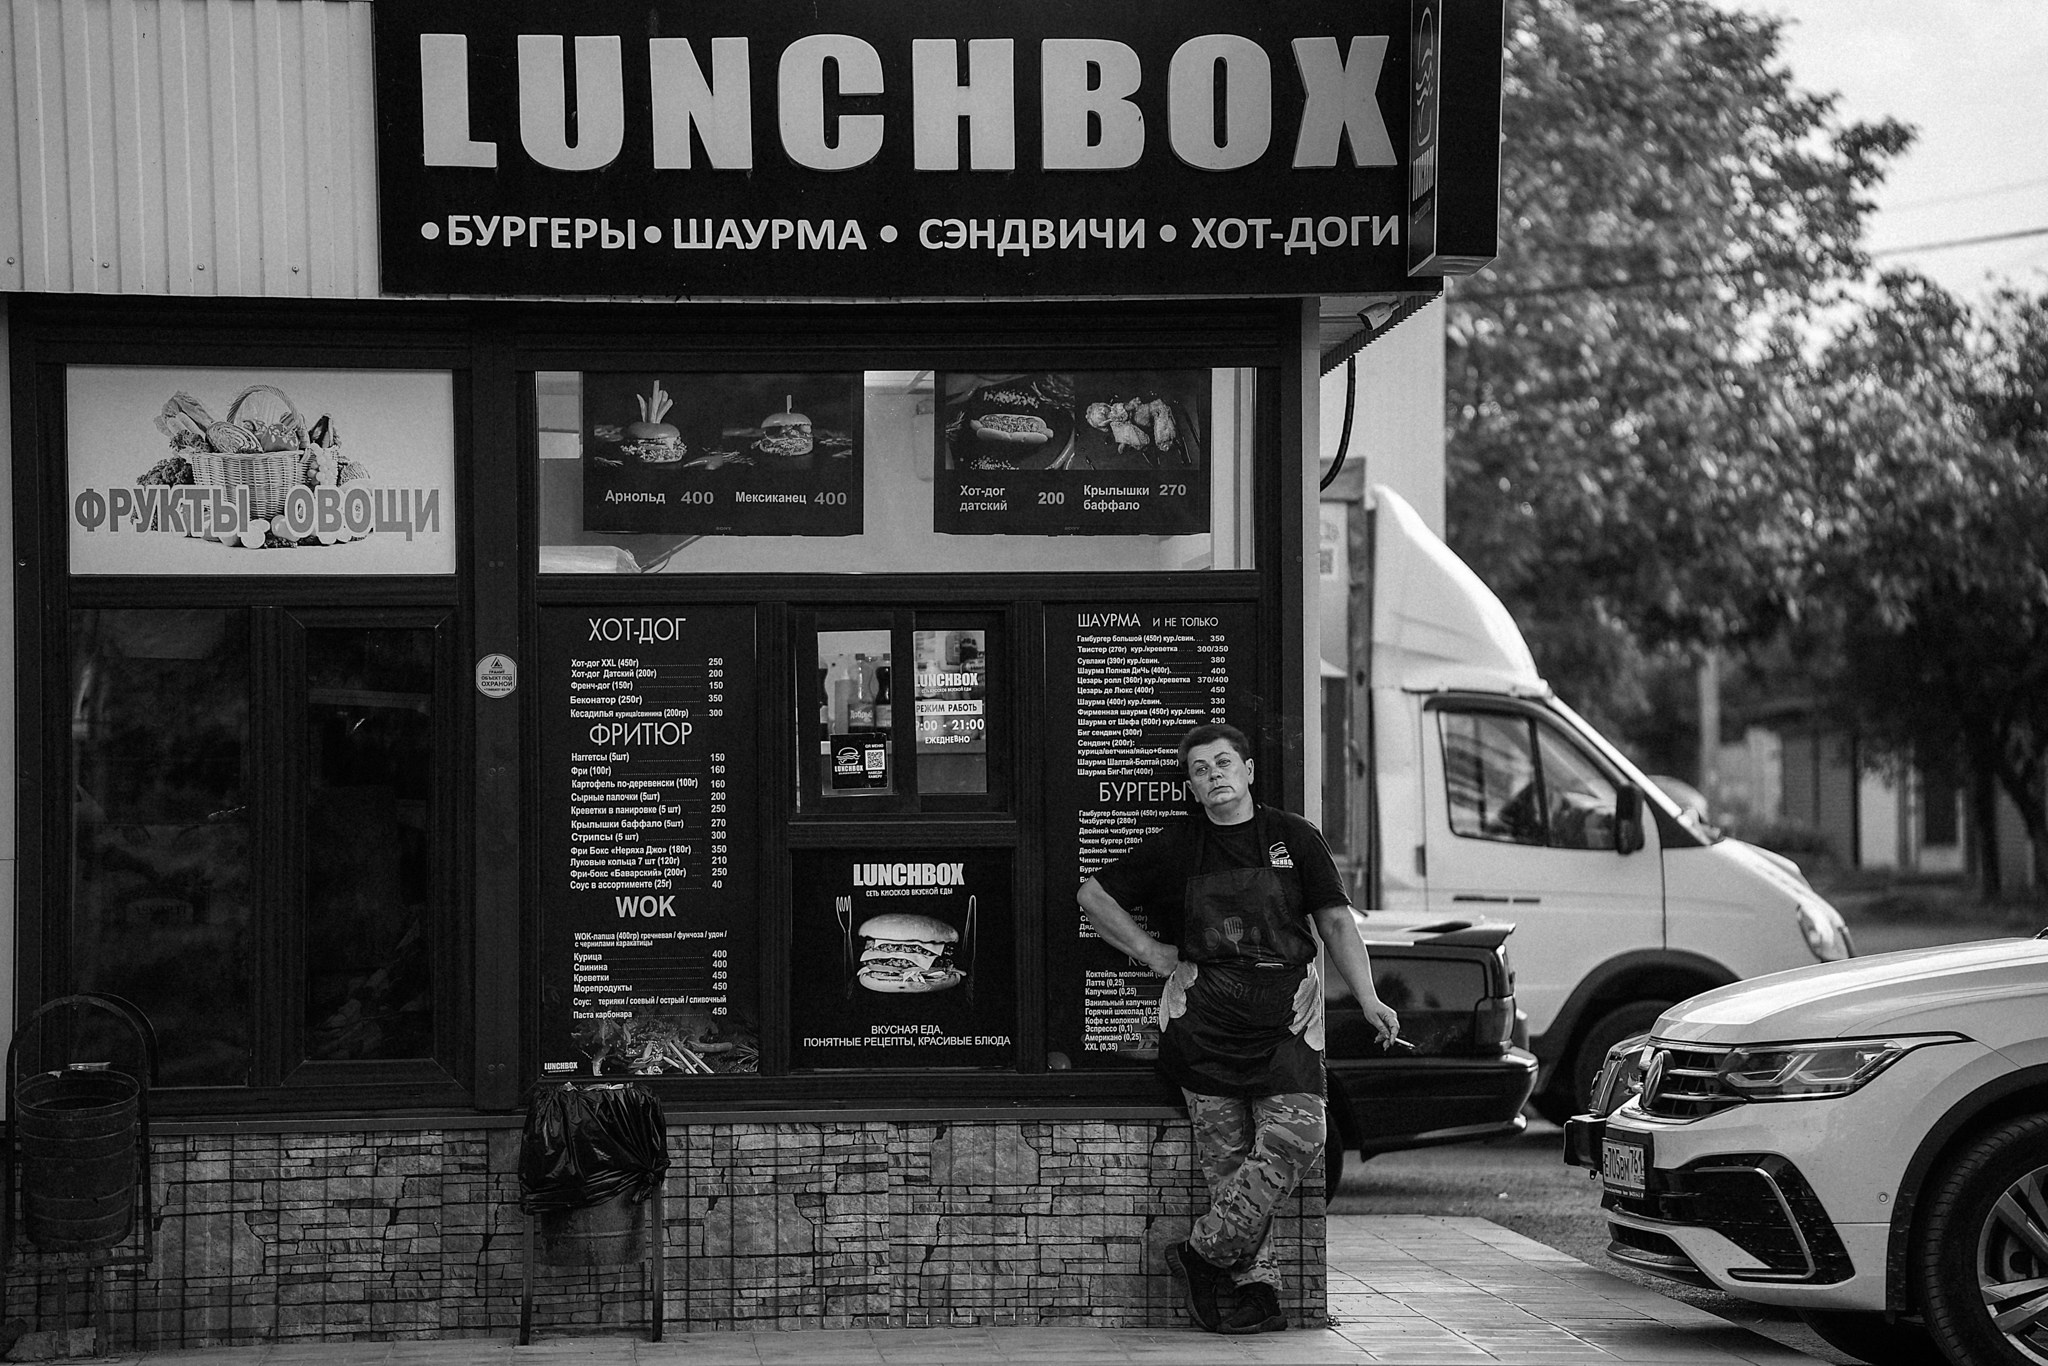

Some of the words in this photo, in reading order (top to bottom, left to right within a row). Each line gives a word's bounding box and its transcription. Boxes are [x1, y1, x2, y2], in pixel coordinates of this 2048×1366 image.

[420, 34, 1397, 171] LUNCHBOX
[448, 215, 635, 249] БУРГЕРЫ
[674, 219, 867, 249] ШАУРМА
[919, 219, 1144, 257] СЭНДВИЧИ
[1192, 215, 1398, 255] ХОТ-ДОГИ
[960, 485, 1005, 497] Хот-дог
[1038, 492, 1064, 504] 200
[1084, 485, 1149, 497] Крылышки
[1160, 485, 1186, 495] 270
[605, 490, 665, 507] Арнольд
[681, 492, 713, 504] 400
[736, 492, 806, 504] Мексиканец
[814, 492, 846, 505] 400
[960, 500, 1007, 512] датский
[1084, 499, 1139, 512] баффало
[75, 487, 248, 533] ФРУКТЫ
[286, 488, 440, 540] ОВОЩИ
[1078, 614, 1141, 627] ШАУРМА
[1153, 618, 1160, 626] И
[1165, 618, 1176, 626] НЕ
[1181, 617, 1218, 626] ТОЛЬКО
[589, 618, 686, 644] ХОТ-ДОГ
[1077, 635, 1111, 643] Гамбургер
[1078, 646, 1107, 654] Твистер
[572, 659, 600, 668] Хот-дог
[618, 659, 638, 668] (450г)
[572, 670, 600, 678] Хот-дог
[603, 669, 634, 678] Датский
[636, 669, 656, 679] (200г)
[916, 672, 978, 686] LUNCHBOX
[571, 682, 610, 691] Френч-дог
[612, 681, 633, 690] (150г)
[570, 696, 616, 705] Беконатор
[618, 696, 642, 705] (250г)
[709, 694, 722, 702] 350
[571, 709, 613, 718] Кесадилья
[664, 709, 688, 718] (200гр)
[952, 719, 984, 730] 21:00
[590, 722, 692, 745] ФРИТЮР
[925, 735, 970, 744] ЕЖЕДНЕВНО
[572, 753, 607, 761] Наггетсы
[609, 752, 629, 762] (5шт)
[711, 753, 725, 761] 150
[571, 767, 587, 776] Фри
[590, 766, 611, 776] (100г)
[711, 765, 725, 773] 160
[572, 780, 615, 790] Картофель
[617, 781, 674, 789] по-деревенски
[676, 778, 698, 788] (100г)
[711, 780, 725, 788] 160
[1100, 782, 1185, 801] БУРГЕРЫ
[571, 793, 604, 803] Сырные
[640, 792, 660, 802] (5шт)
[711, 792, 725, 800] 200
[571, 806, 606, 816] Креветки
[616, 807, 657, 815] панировке
[572, 820, 619, 830] Крылышки
[621, 819, 662, 829] баффало
[664, 820, 683, 828] (5шт)
[712, 819, 726, 827] 270
[572, 833, 612, 843] Стрипсы
[712, 831, 726, 839] 300
[571, 847, 587, 856] Фри
[611, 846, 644, 855] «Неряха
[646, 846, 666, 855] Джо»
[669, 845, 691, 855] (180г)
[712, 845, 727, 853] 350
[570, 858, 605, 868] Луковые
[638, 857, 642, 865] 7
[658, 857, 679, 866] (120г)
[712, 856, 727, 864] 210
[570, 869, 608, 879] Фри-бокс
[611, 869, 662, 878] «Баварский»
[664, 868, 686, 878] (200г)
[712, 868, 727, 876] 250
[854, 863, 964, 886] LUNCHBOX
[570, 881, 589, 891] Соус
[598, 882, 652, 890] ассортименте
[655, 879, 671, 889] (25г)
[712, 880, 722, 888] 40
[912, 887, 938, 895] ВКУСНОЙ
[616, 896, 676, 917] WOK
[574, 953, 602, 962] Курица
[712, 950, 727, 958] 400
[574, 963, 607, 971] Свинина
[713, 960, 727, 968] 400
[574, 974, 609, 983] Креветки
[712, 971, 727, 979] 450
[574, 984, 632, 993] Морепродукты
[713, 982, 727, 990] 450
[573, 998, 591, 1007] Соус:
[630, 996, 655, 1004] соевый
[660, 996, 684, 1005] острый
[689, 995, 726, 1003] сливочный
[596, 1010, 632, 1019] карбонара
[712, 1007, 727, 1015] 450
[1085, 1008, 1113, 1017] Горячий
[1085, 1017, 1103, 1025] Кофе
[872, 1025, 917, 1034] ВКУСНАЯ
[921, 1025, 943, 1035] ЕДА,
[804, 1038, 861, 1046] ПОНЯТНЫЕ
[864, 1037, 915, 1047] РЕЦЕПТЫ,
[919, 1037, 972, 1045] КРАСИВЫЕ
[975, 1036, 1010, 1046] БЛЮДА
[545, 1062, 577, 1070] LUNCHBOX
